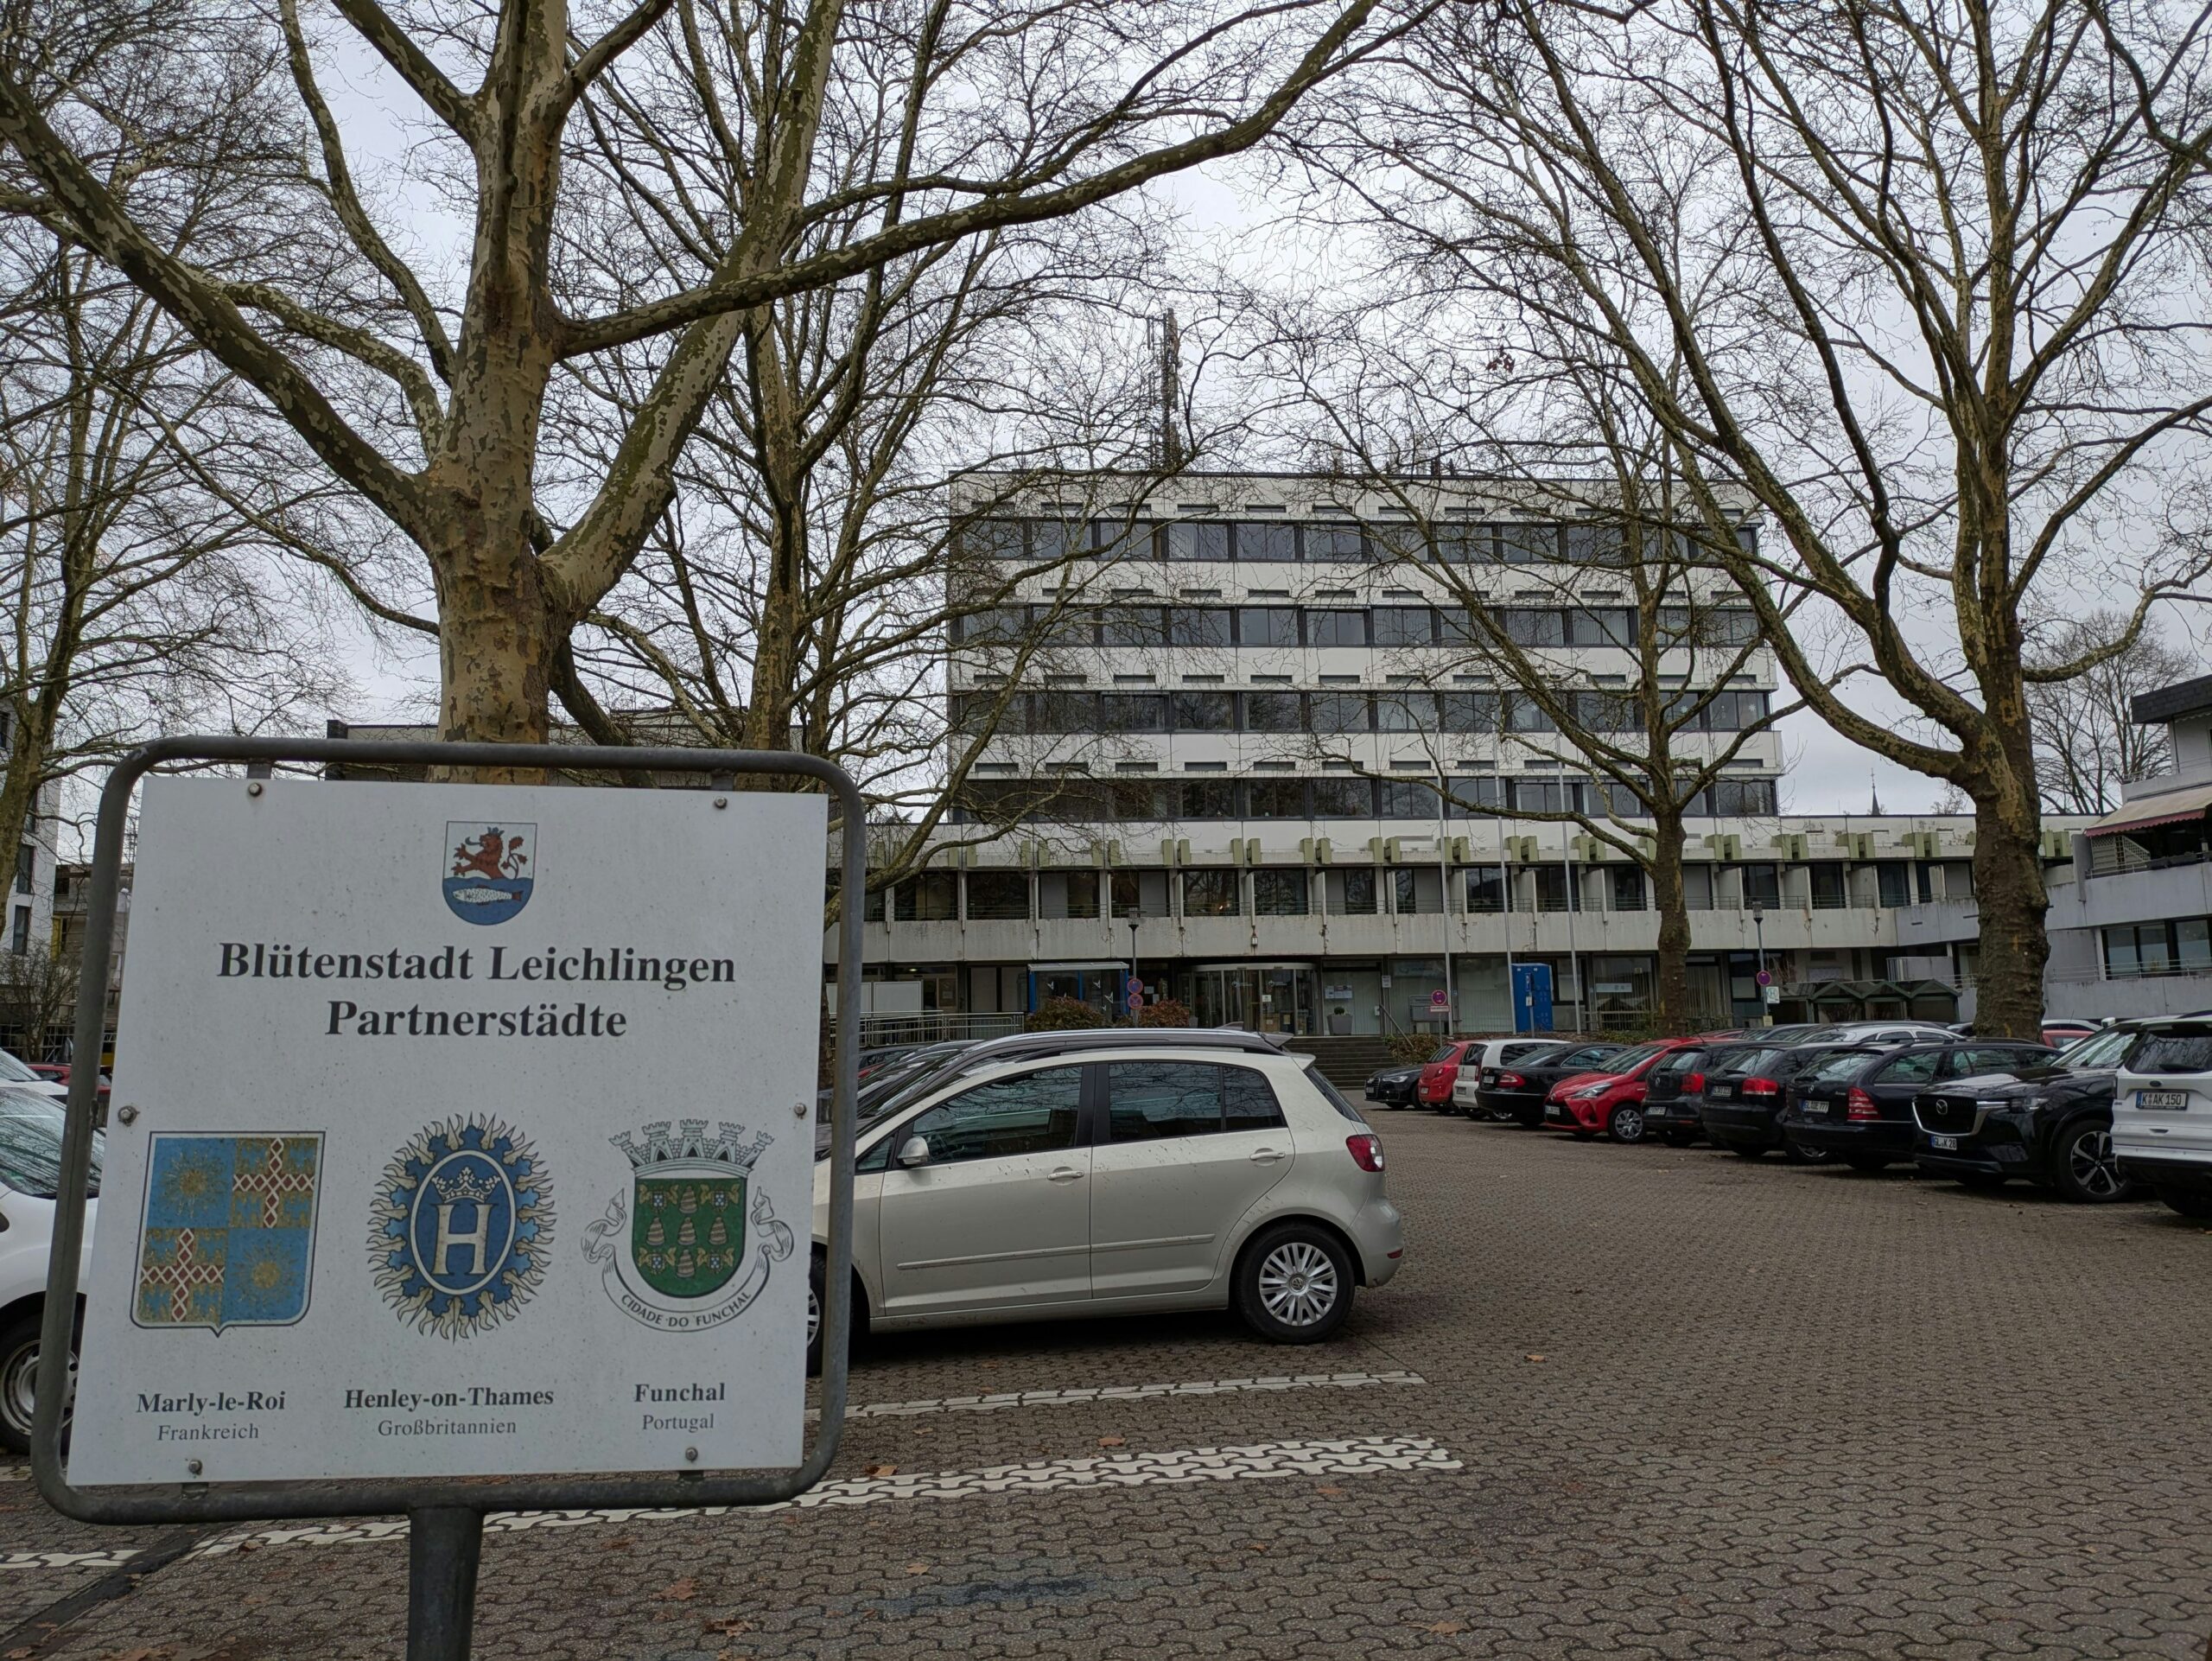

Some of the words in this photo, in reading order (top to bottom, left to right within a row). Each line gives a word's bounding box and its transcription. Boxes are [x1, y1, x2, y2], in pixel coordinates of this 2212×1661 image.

[216, 942, 474, 980] Blütenstadt
[487, 946, 735, 991] Leichlingen
[324, 1001, 626, 1037] Partnerstädte
[2141, 1094, 2148, 1105] K
[2152, 1094, 2164, 1105] AK
[2165, 1094, 2182, 1105] 150
[620, 1294, 664, 1325] CIDADE
[668, 1316, 690, 1327] DO
[695, 1291, 752, 1327] FUNCHAL
[136, 1391, 286, 1416] Marly-le-Roi
[344, 1387, 554, 1413] Henley-on-Thames
[634, 1382, 725, 1403] Funchal
[156, 1422, 259, 1441] Frankreich
[378, 1419, 517, 1436] Großbritannien
[642, 1413, 714, 1434] Portugal
